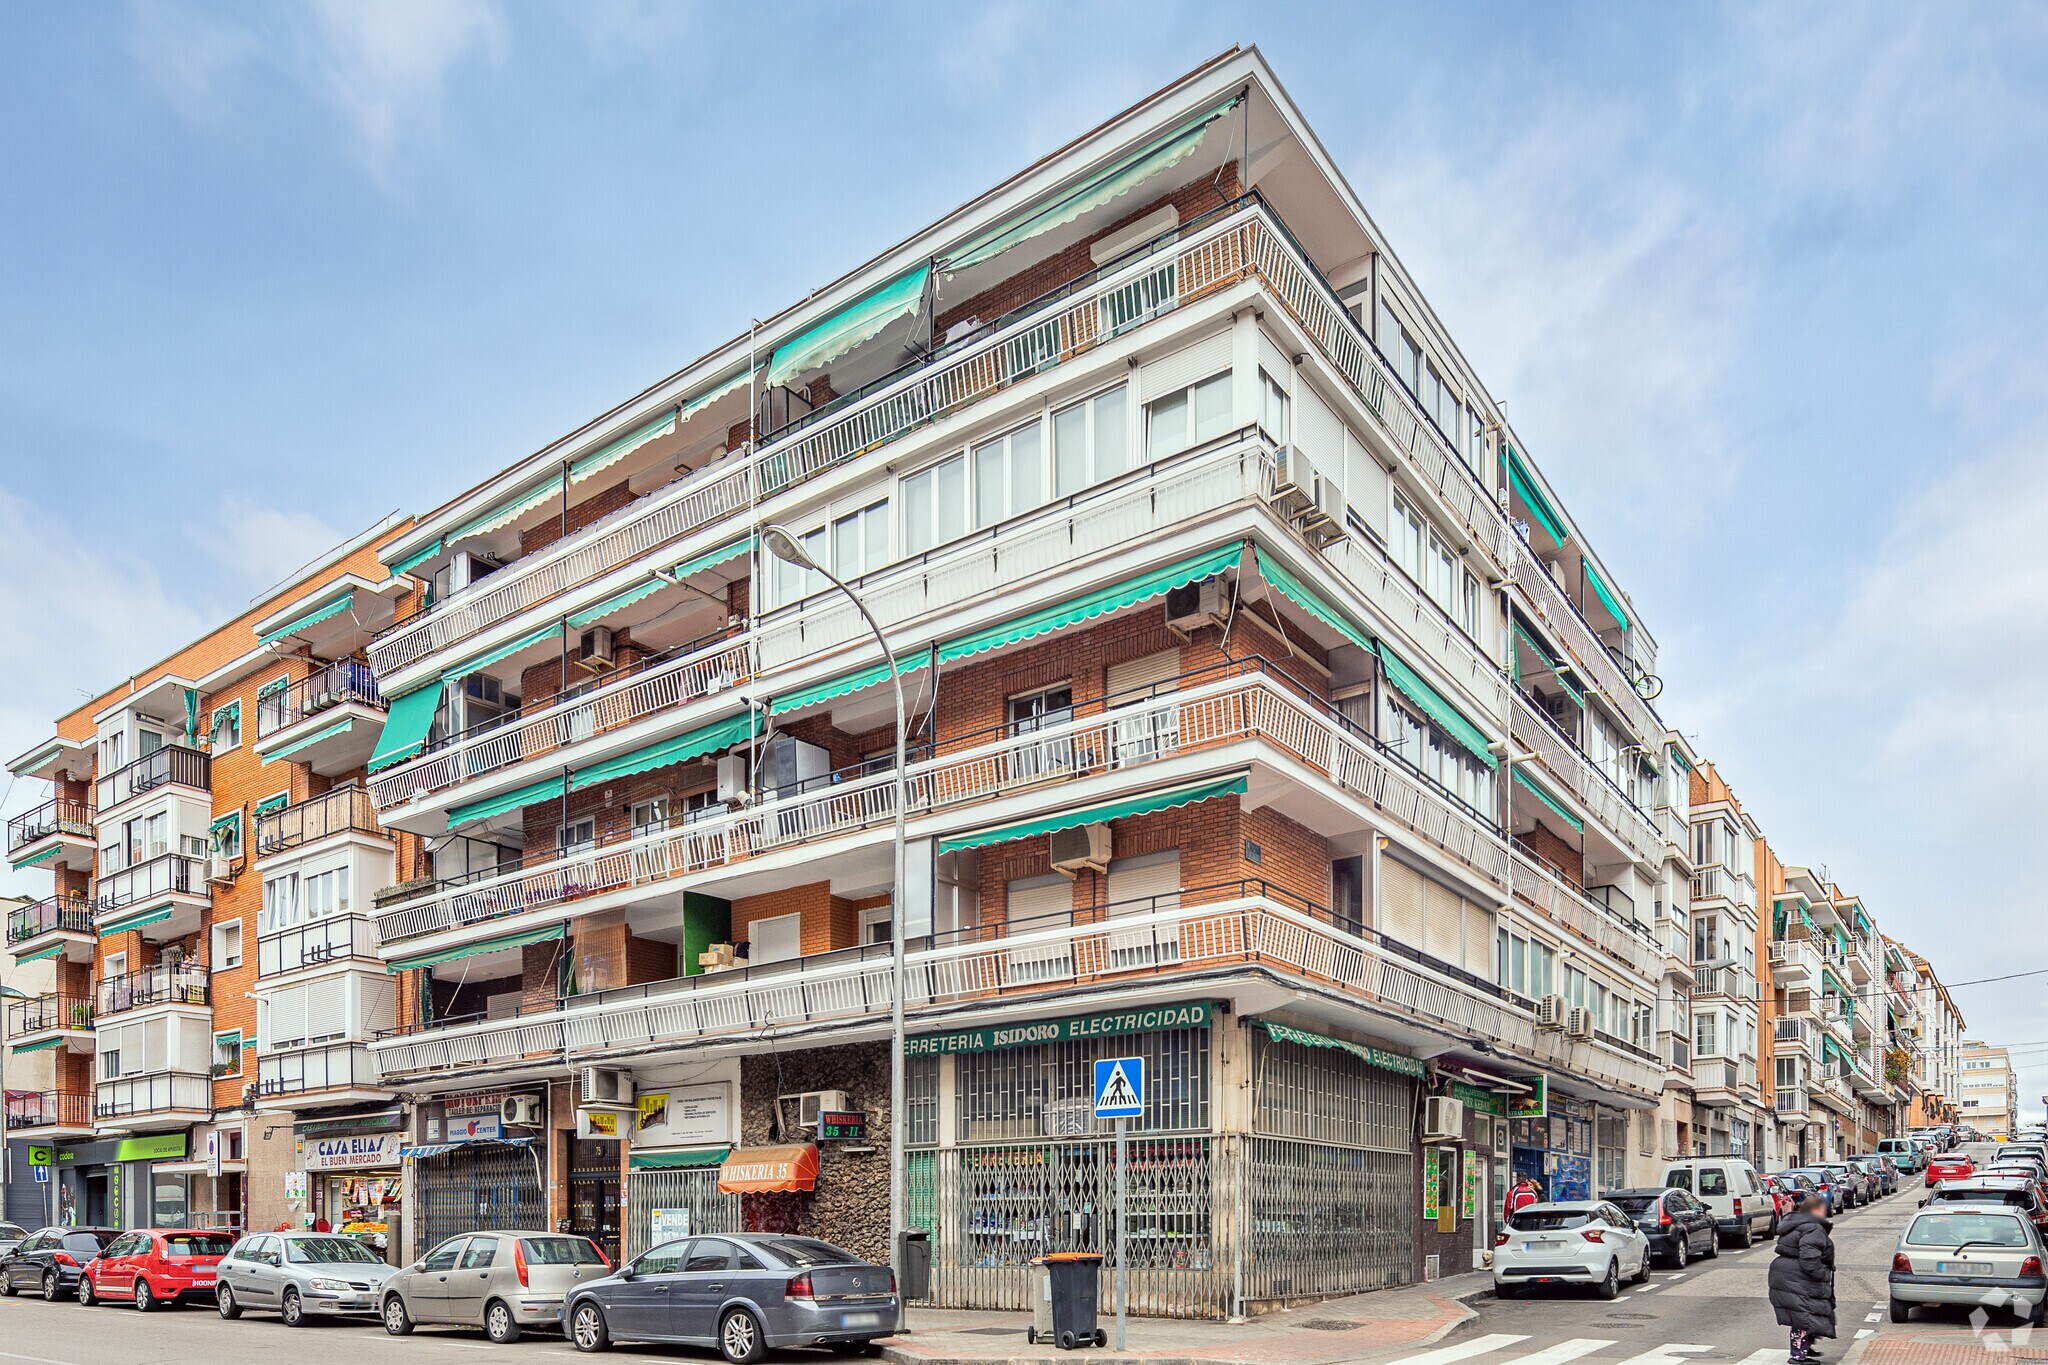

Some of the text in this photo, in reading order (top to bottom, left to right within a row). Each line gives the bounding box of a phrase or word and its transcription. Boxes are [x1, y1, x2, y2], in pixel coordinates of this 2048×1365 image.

[903, 1033, 984, 1055] ERRETERIA
[993, 1023, 1060, 1047] ISIDORO
[1069, 1006, 1204, 1037] ELECTRICIDAD
[825, 1114, 863, 1125] WHISKERIA
[476, 1126, 496, 1134] CENTER
[825, 1126, 839, 1137] 35
[319, 1140, 348, 1156] CASA
[351, 1136, 385, 1154] ELIAS
[34, 1150, 47, 1162] C
[321, 1153, 382, 1167] EL BUEN MERCADO
[721, 1163, 788, 1182] WHISKERIA 35
[661, 1213, 689, 1227] VENDE
